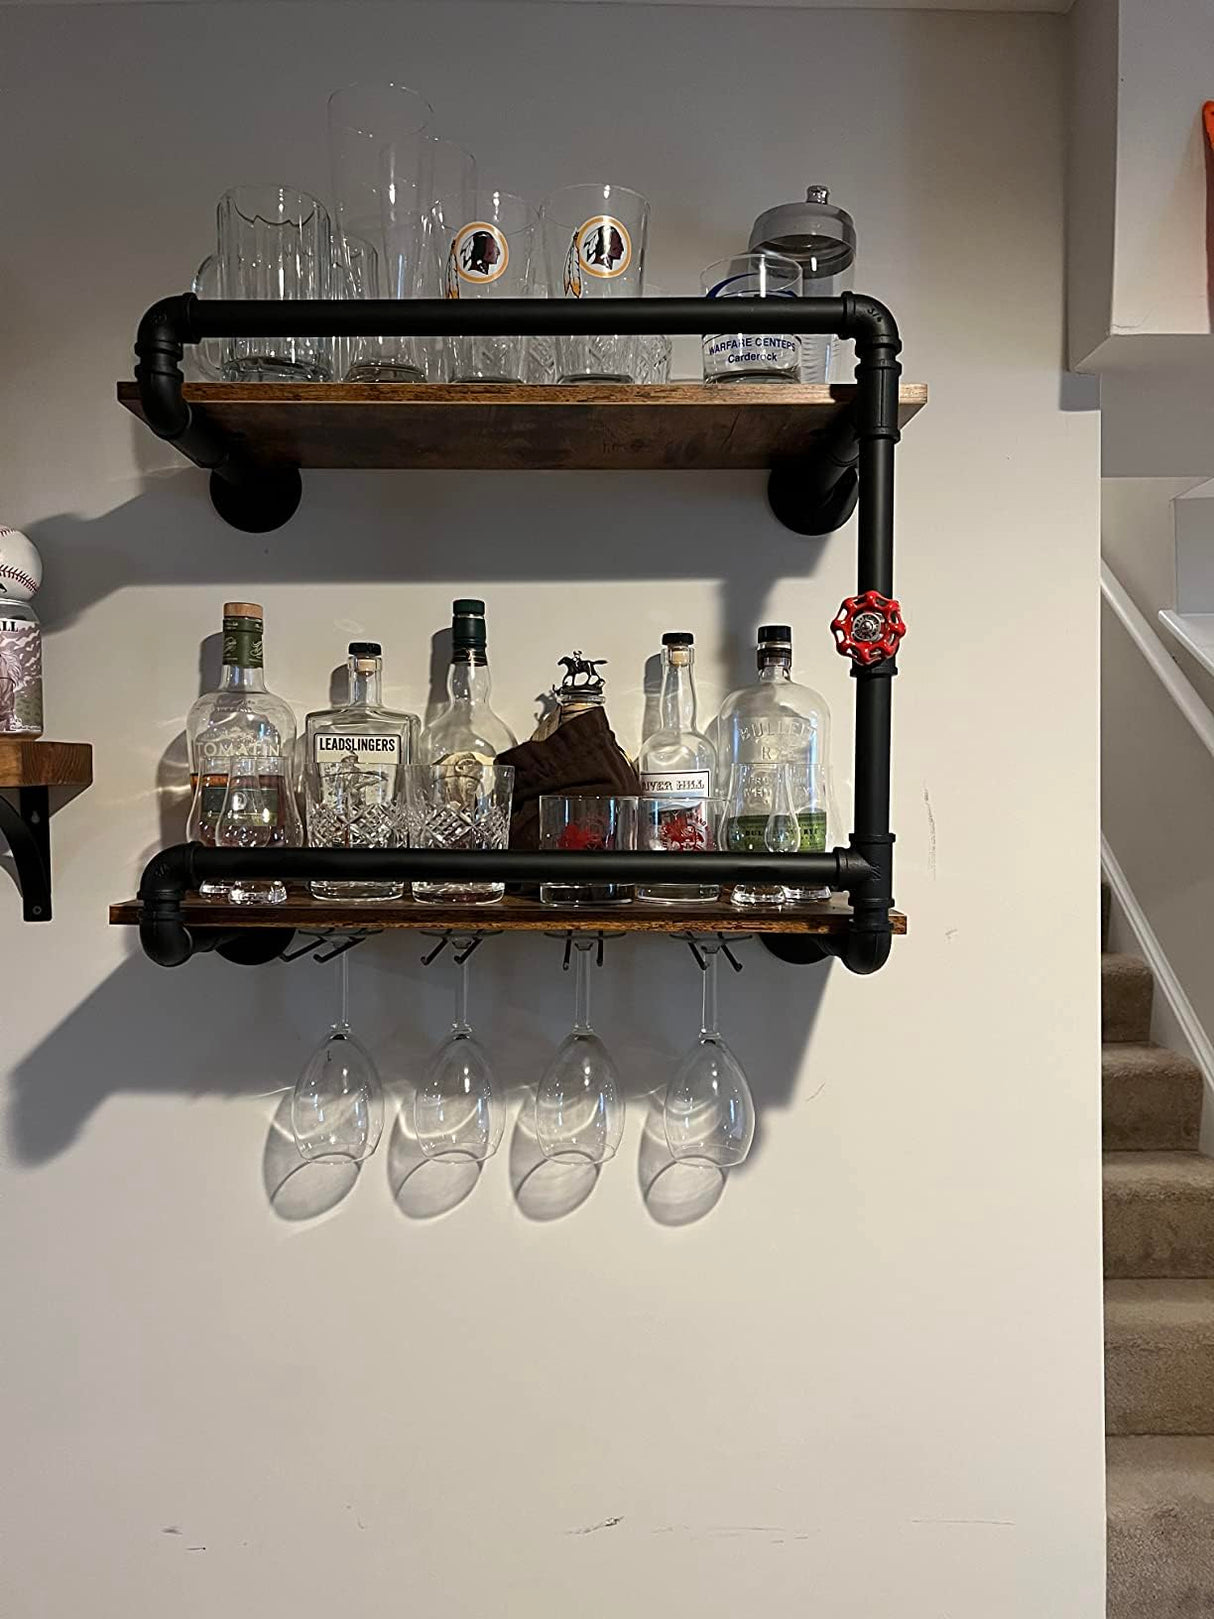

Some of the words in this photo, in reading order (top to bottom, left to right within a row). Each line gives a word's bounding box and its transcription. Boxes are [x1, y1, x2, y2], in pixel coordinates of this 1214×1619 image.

[708, 337, 752, 355] WARFARE
[727, 352, 778, 364] Carderock
[0, 620, 19, 632] LL
[195, 741, 281, 757] TOMATIN
[319, 737, 396, 751] LEADSLINGERS
[676, 779, 705, 791] HILL
